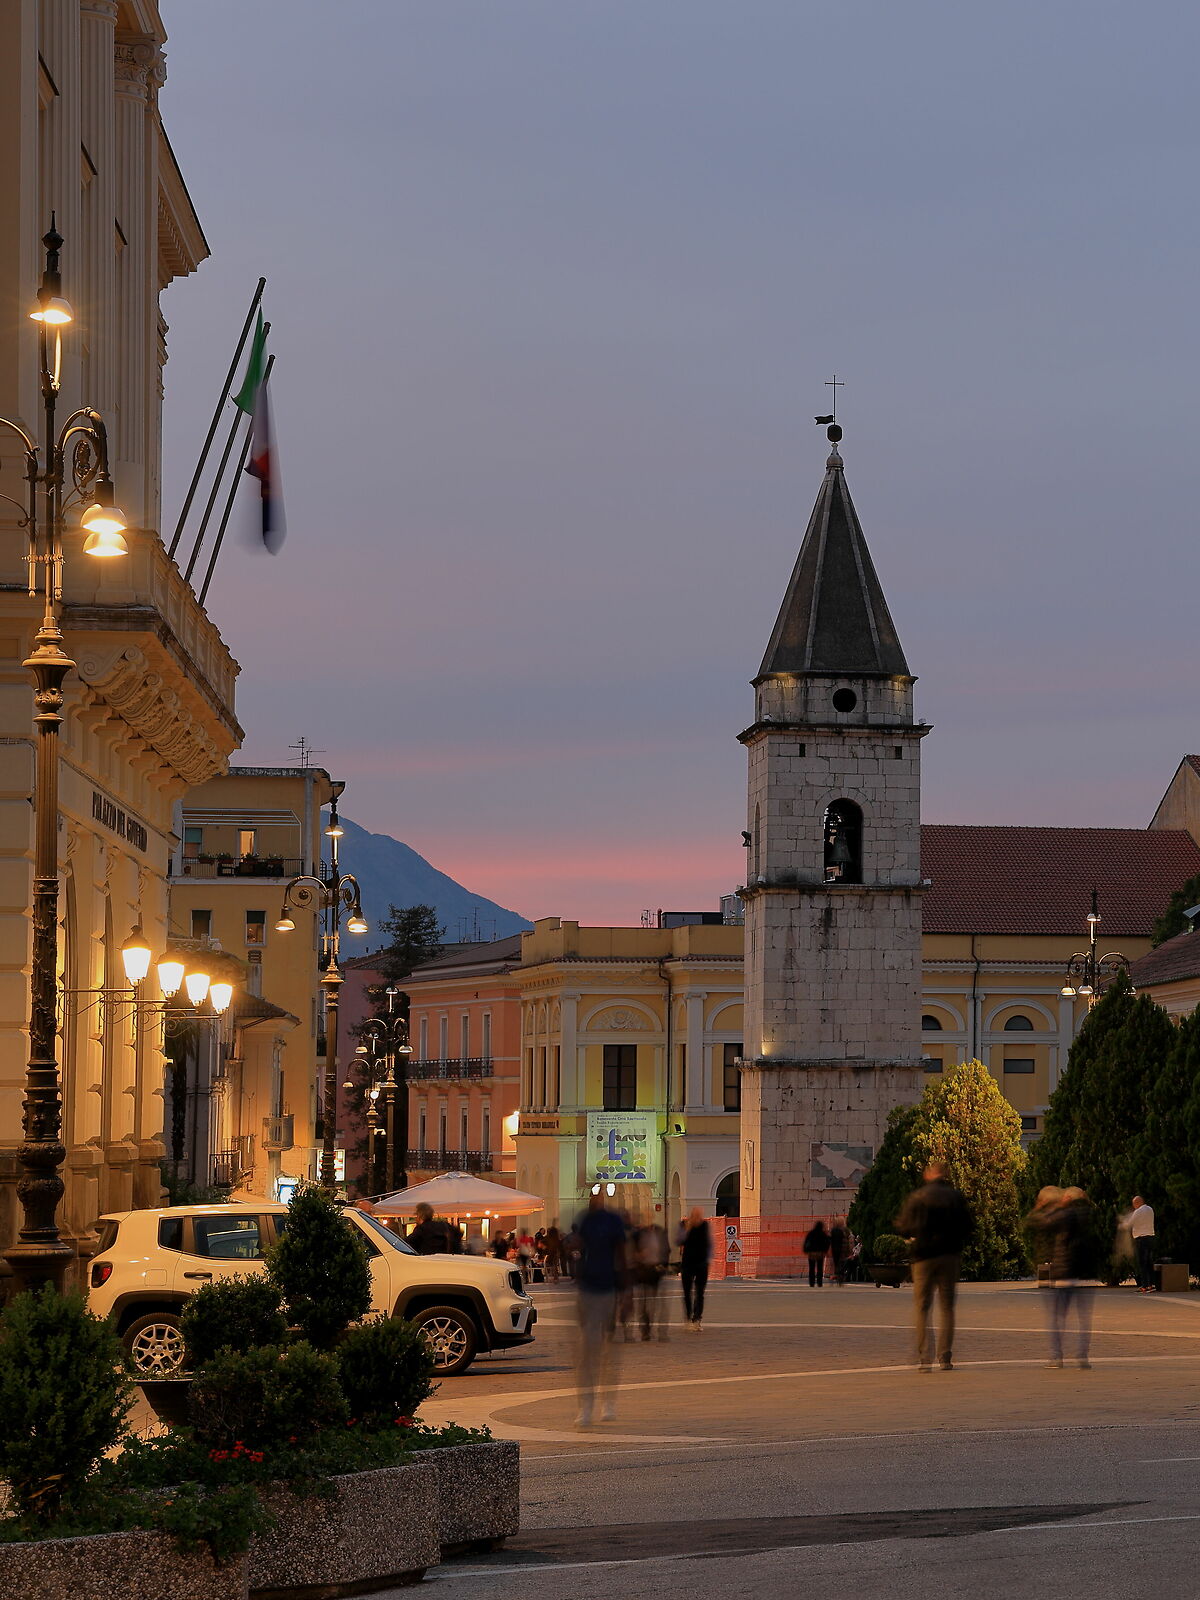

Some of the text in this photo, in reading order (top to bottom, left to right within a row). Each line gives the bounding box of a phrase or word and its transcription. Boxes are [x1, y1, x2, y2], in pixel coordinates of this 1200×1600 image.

[92, 791, 148, 852] PALAZZO DEL GOVERNO
